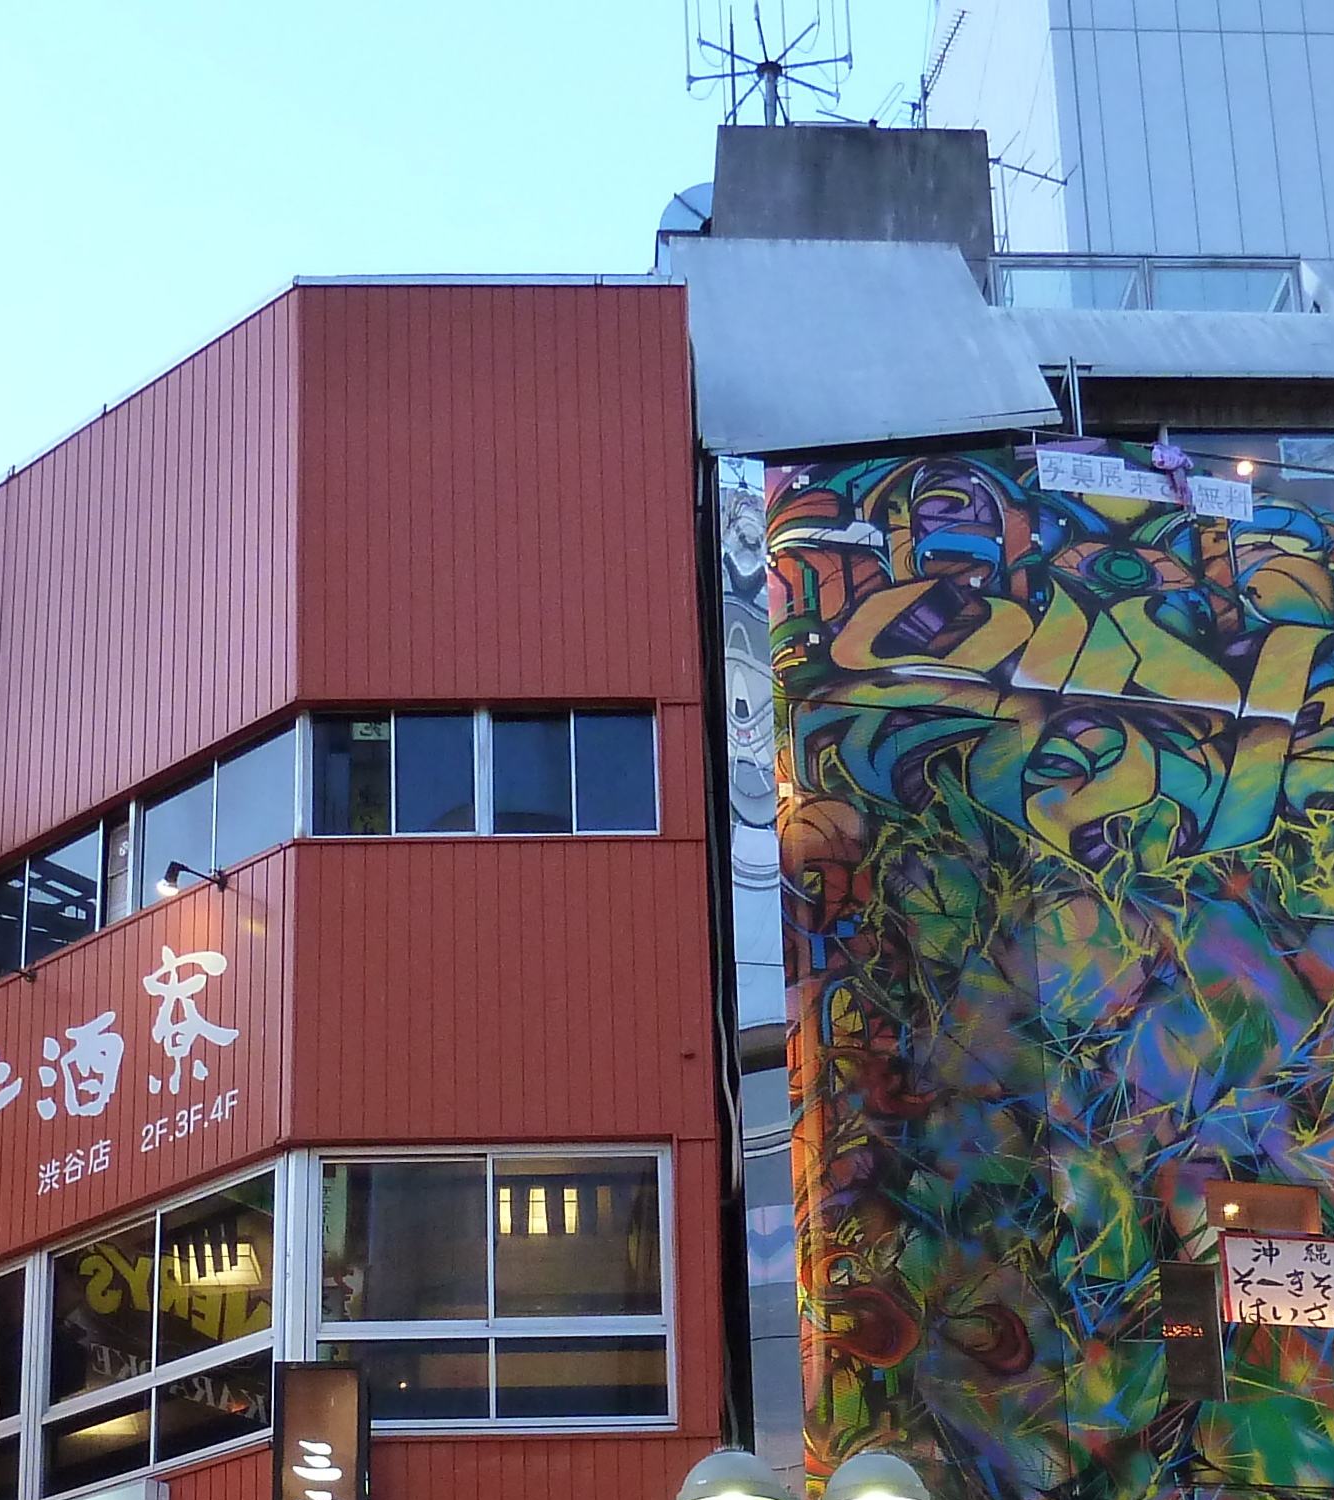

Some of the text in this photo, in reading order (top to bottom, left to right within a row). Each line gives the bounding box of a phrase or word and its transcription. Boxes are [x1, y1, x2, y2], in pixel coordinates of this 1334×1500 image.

[1041, 455, 1124, 490] 写真展
[1195, 483, 1248, 517] 無料
[37, 1088, 240, 1196] 渋谷店 2F.3F.4F
[1251, 1239, 1333, 1267] 沖縄
